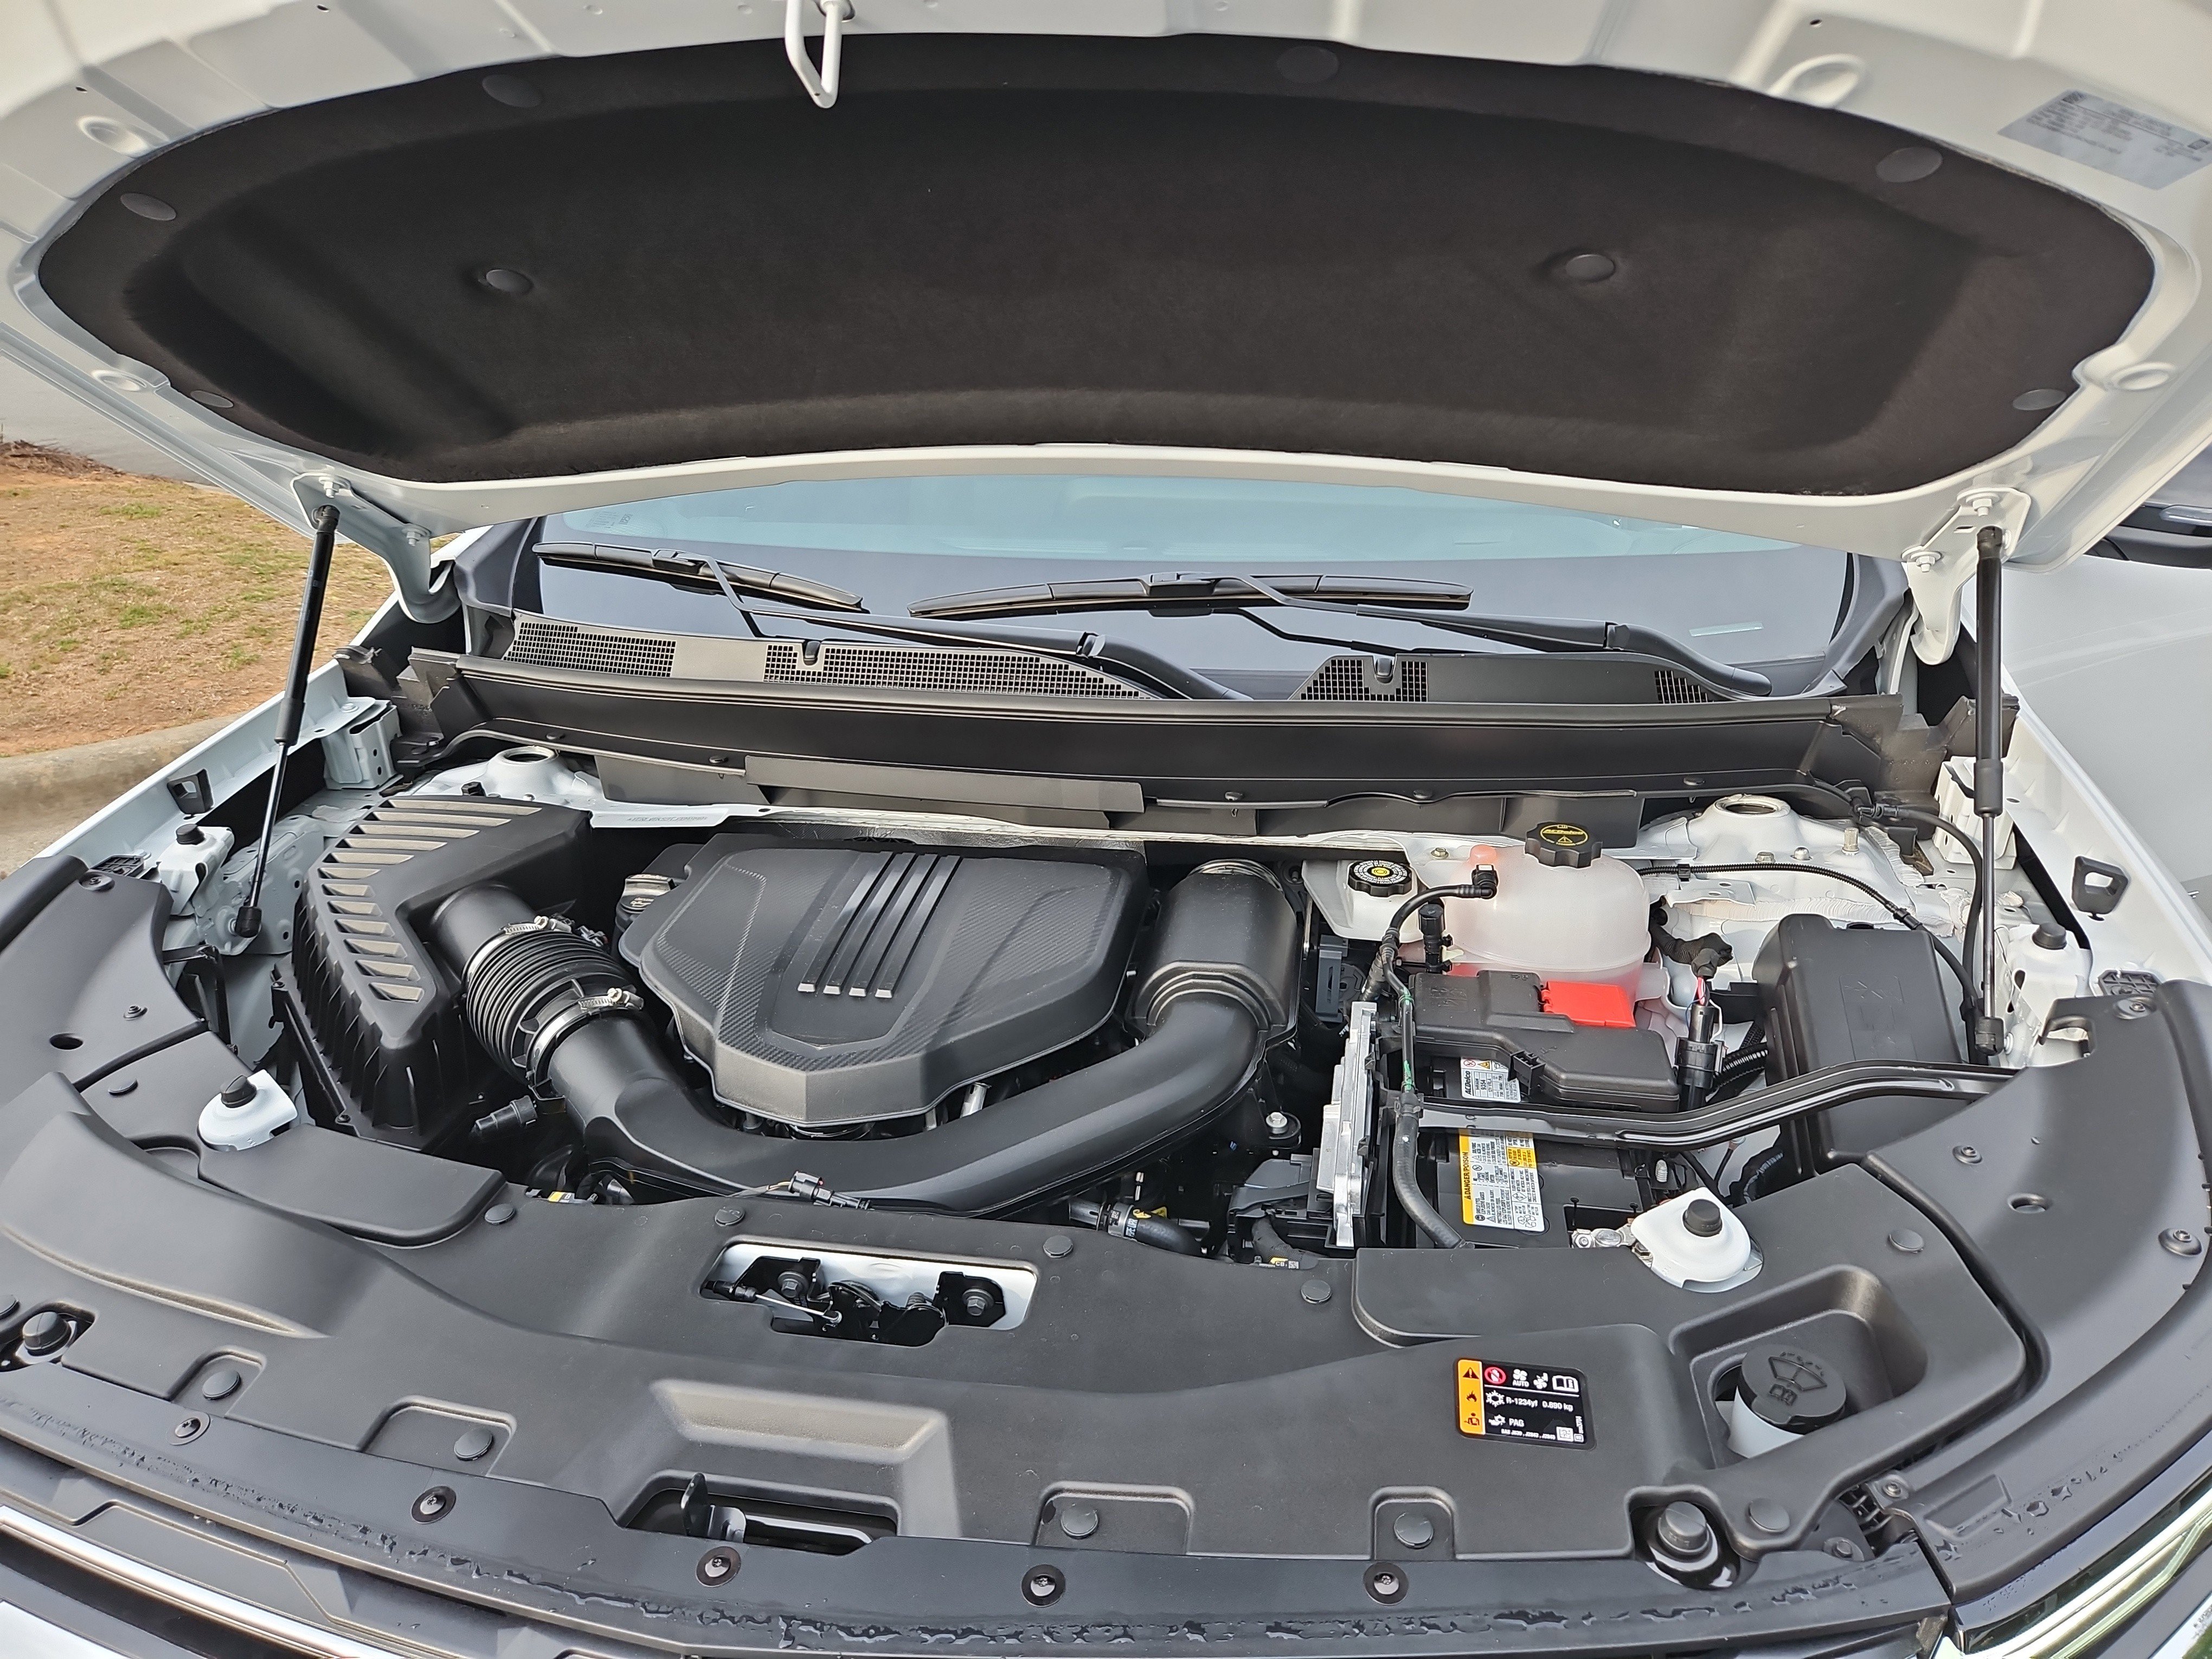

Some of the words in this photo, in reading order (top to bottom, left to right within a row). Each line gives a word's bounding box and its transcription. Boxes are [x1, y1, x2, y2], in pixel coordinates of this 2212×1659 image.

[1462, 1152, 1470, 1195] DANGER/POISON
[1513, 1379, 1529, 1387] AUTO
[1506, 1396, 1538, 1408] R-1234yf
[1563, 1403, 1573, 1412] kg
[1509, 1418, 1525, 1427] PAG
